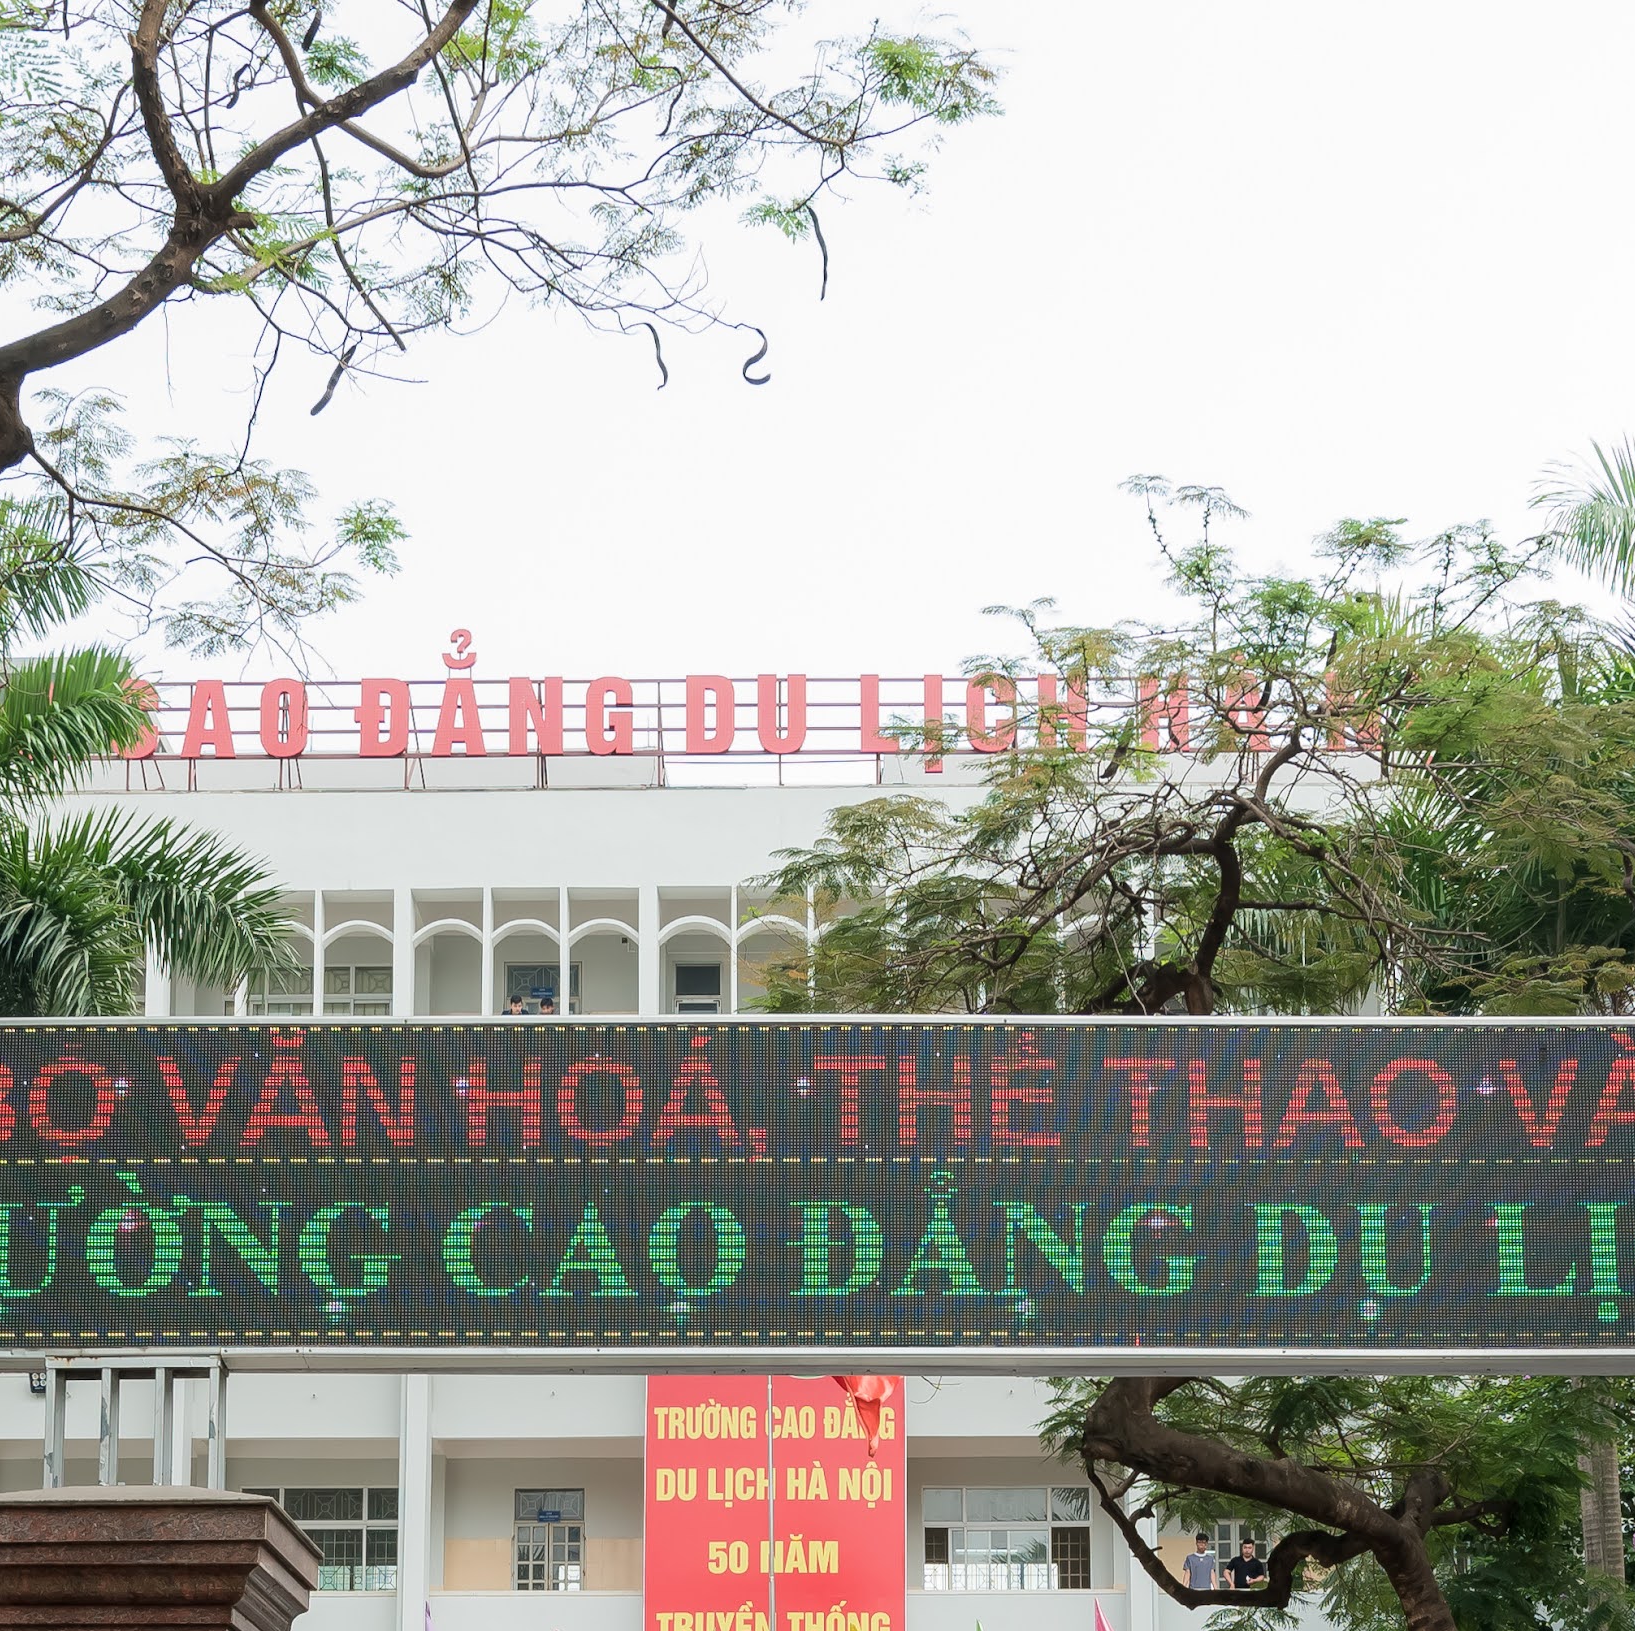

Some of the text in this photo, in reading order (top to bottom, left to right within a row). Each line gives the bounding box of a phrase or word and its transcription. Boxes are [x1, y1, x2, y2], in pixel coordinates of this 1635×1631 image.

[353, 628, 634, 757] ĐẲNG
[686, 674, 807, 755] DU
[157, 1028, 415, 1147] VĂN
[467, 1035, 766, 1162] HOÁ,
[1103, 1056, 1458, 1147] THAO
[441, 1201, 746, 1298] CAO
[786, 1170, 1206, 1298] ĐẲNG
[654, 1399, 757, 1440] TRƯỜNG
[765, 1405, 816, 1440] CAO
[656, 1461, 893, 1508] DU LỊCH HÀ NỘI
[707, 1533, 839, 1574] 50 NĂM
